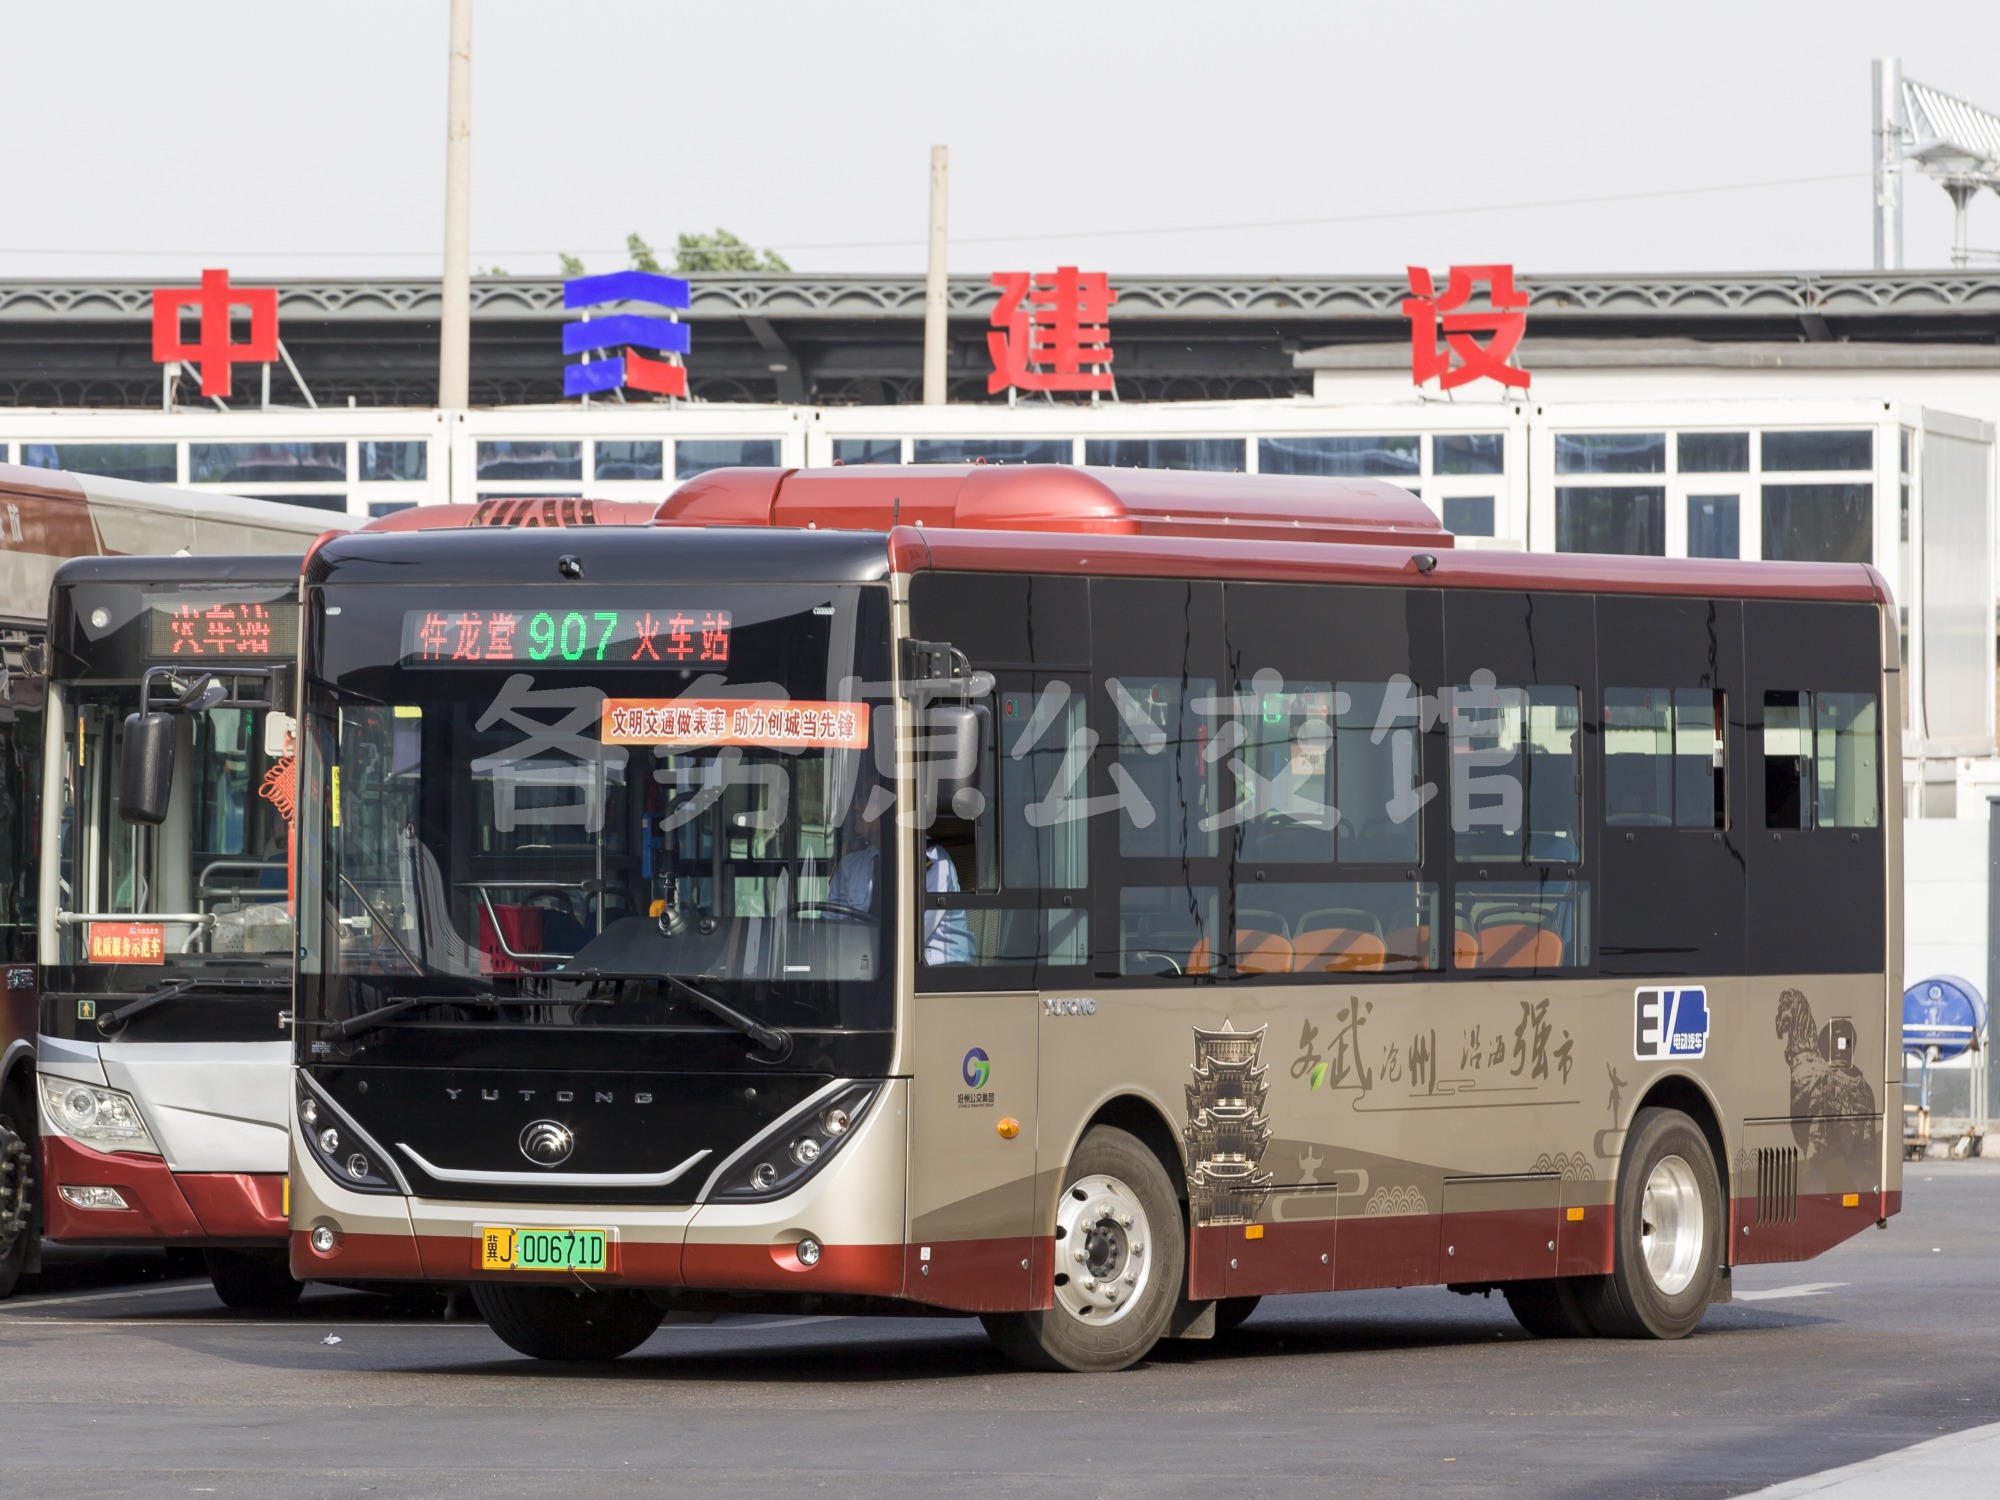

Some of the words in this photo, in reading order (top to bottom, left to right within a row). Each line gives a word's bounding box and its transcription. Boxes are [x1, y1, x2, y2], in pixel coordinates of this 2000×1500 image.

[528, 612, 617, 661] 907
[631, 612, 730, 661] 火车站
[611, 707, 727, 737] 文明交通做表率
[732, 708, 857, 740] 助力创城当先锋
[1673, 1031, 1703, 1050] 电动汽车
[445, 1087, 654, 1104] YUTONG
